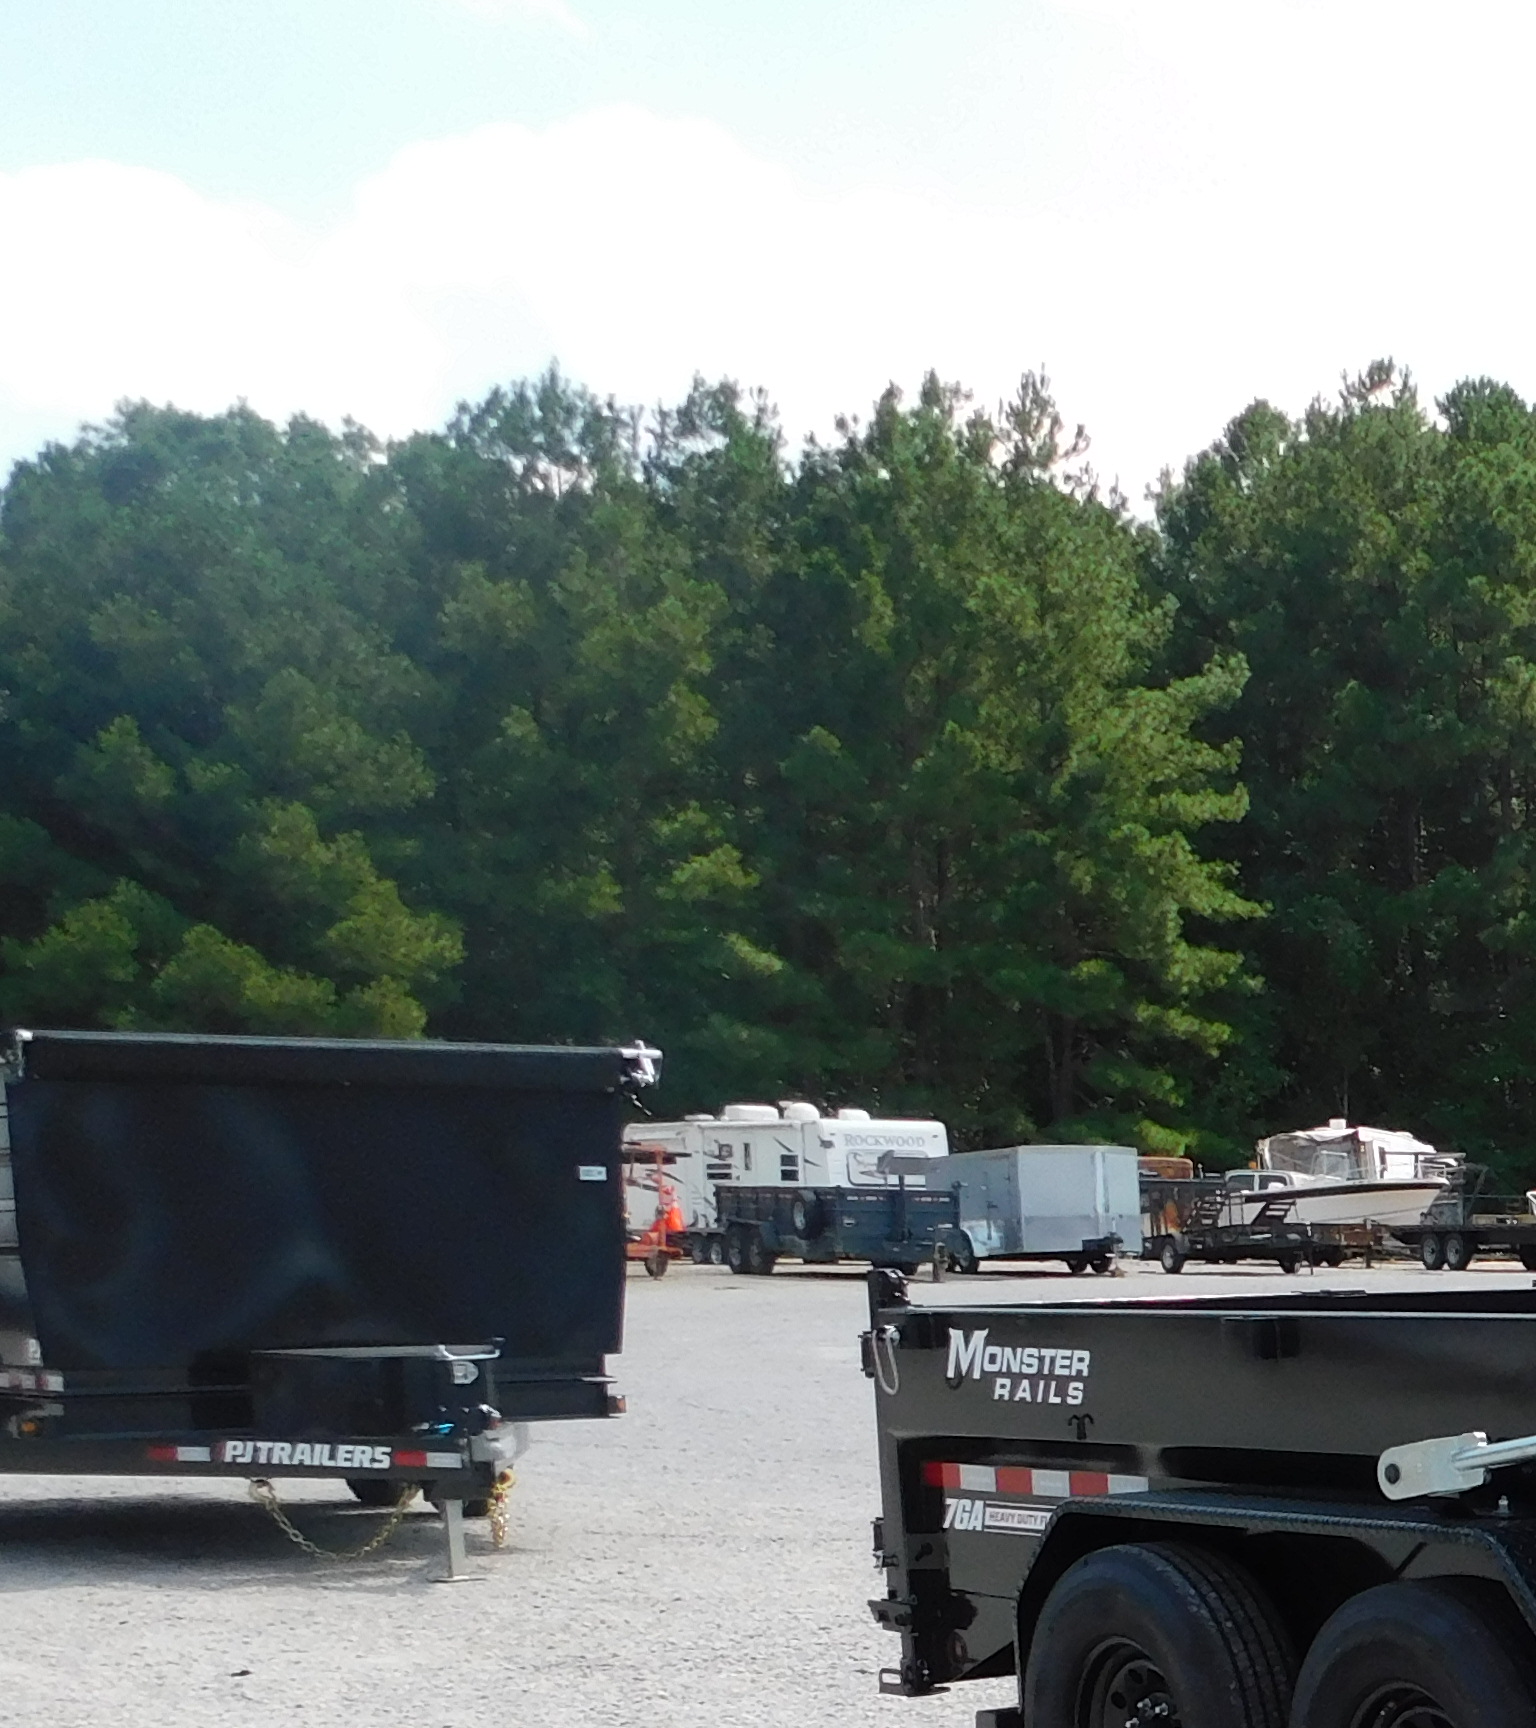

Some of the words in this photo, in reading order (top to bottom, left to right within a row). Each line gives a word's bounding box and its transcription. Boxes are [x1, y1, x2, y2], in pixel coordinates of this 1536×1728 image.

[843, 1133, 926, 1147] ROCKWOOD
[946, 1327, 1091, 1379] MONSTER
[993, 1378, 1084, 1405] RAILS
[942, 1498, 985, 1531] 7GA
